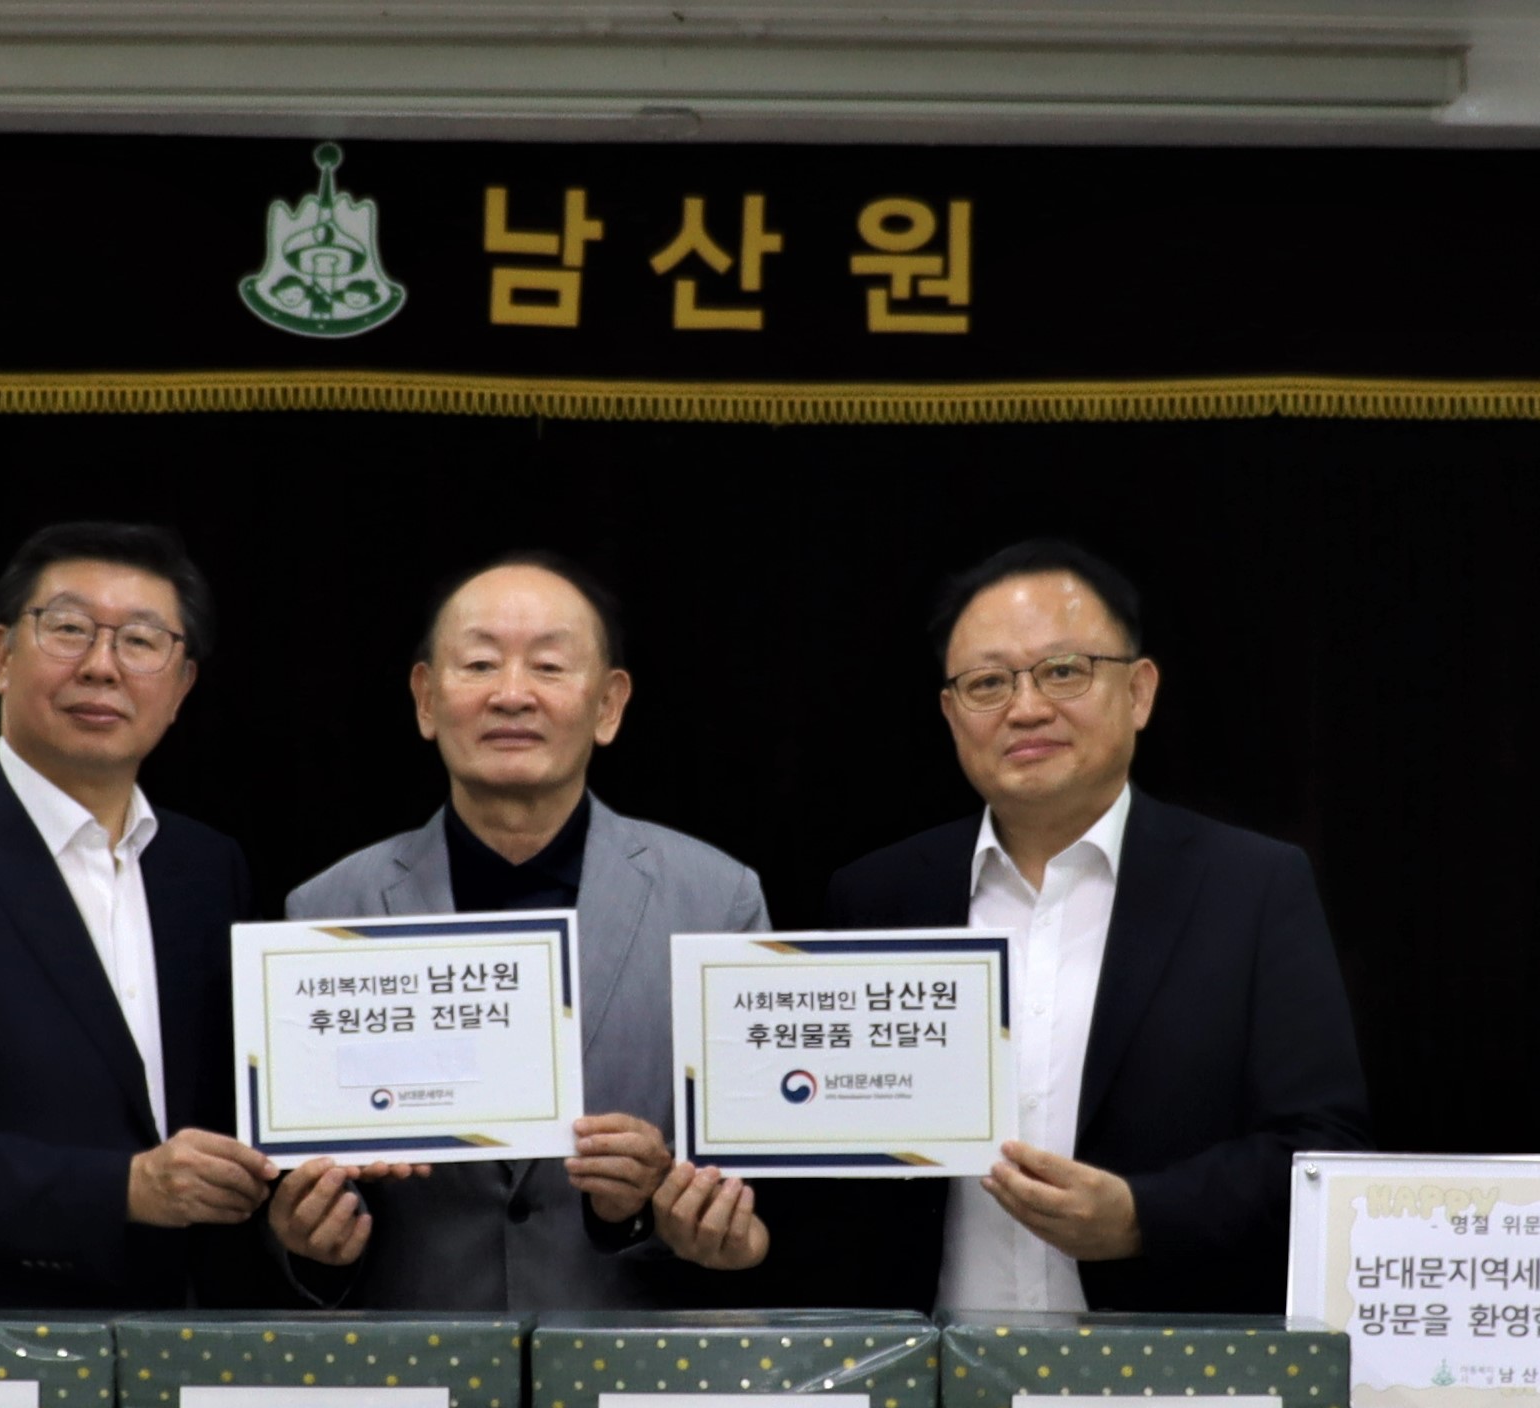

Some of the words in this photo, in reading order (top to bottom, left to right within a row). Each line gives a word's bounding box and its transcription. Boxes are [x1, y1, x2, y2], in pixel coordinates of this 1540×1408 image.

[296, 973, 419, 997] 사회복지법인
[427, 961, 520, 994] 남산원
[734, 990, 857, 1012] 사회복지법인
[865, 979, 958, 1011] 남산원
[308, 1006, 416, 1035] 후원성금
[431, 1002, 511, 1031] 전달식
[745, 1021, 854, 1049] 후원물품
[868, 1020, 948, 1048] 전달식
[1450, 1214, 1490, 1236] 명절
[1358, 1302, 1452, 1338] 방문을
